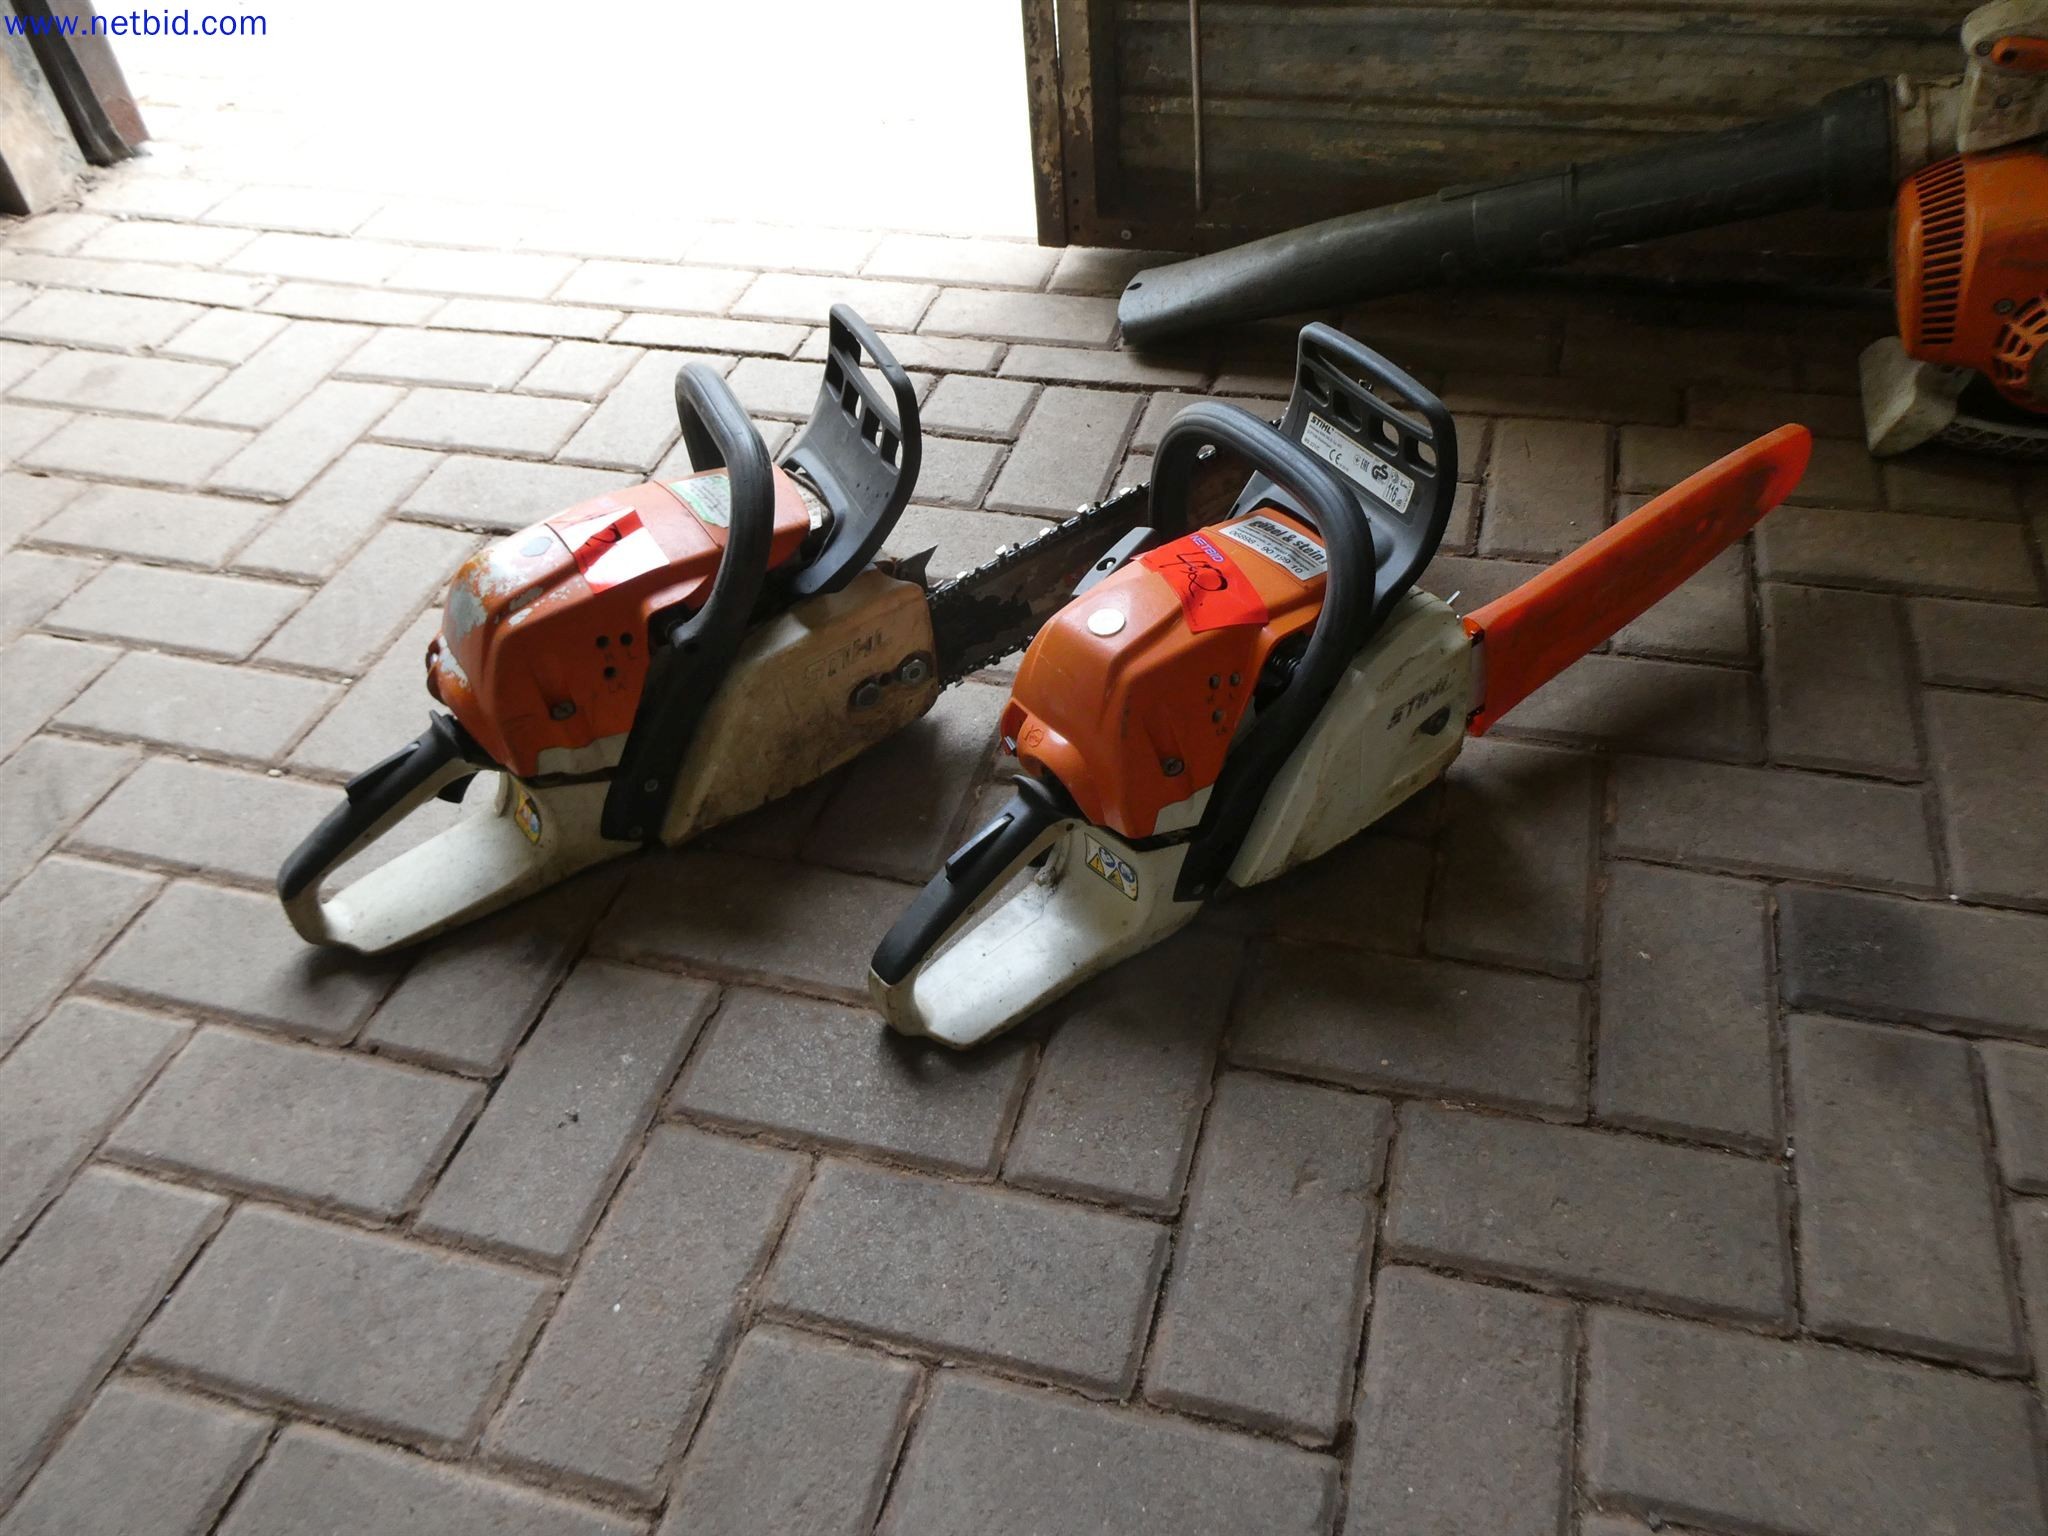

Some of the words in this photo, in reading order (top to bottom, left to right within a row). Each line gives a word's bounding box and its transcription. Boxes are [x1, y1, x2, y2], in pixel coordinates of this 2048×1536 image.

[1310, 416, 1331, 435] STIHL
[1385, 483, 1399, 502] 116
[1190, 534, 1225, 562] NETBID
[1282, 534, 1297, 542] &
[1293, 540, 1324, 561] stein
